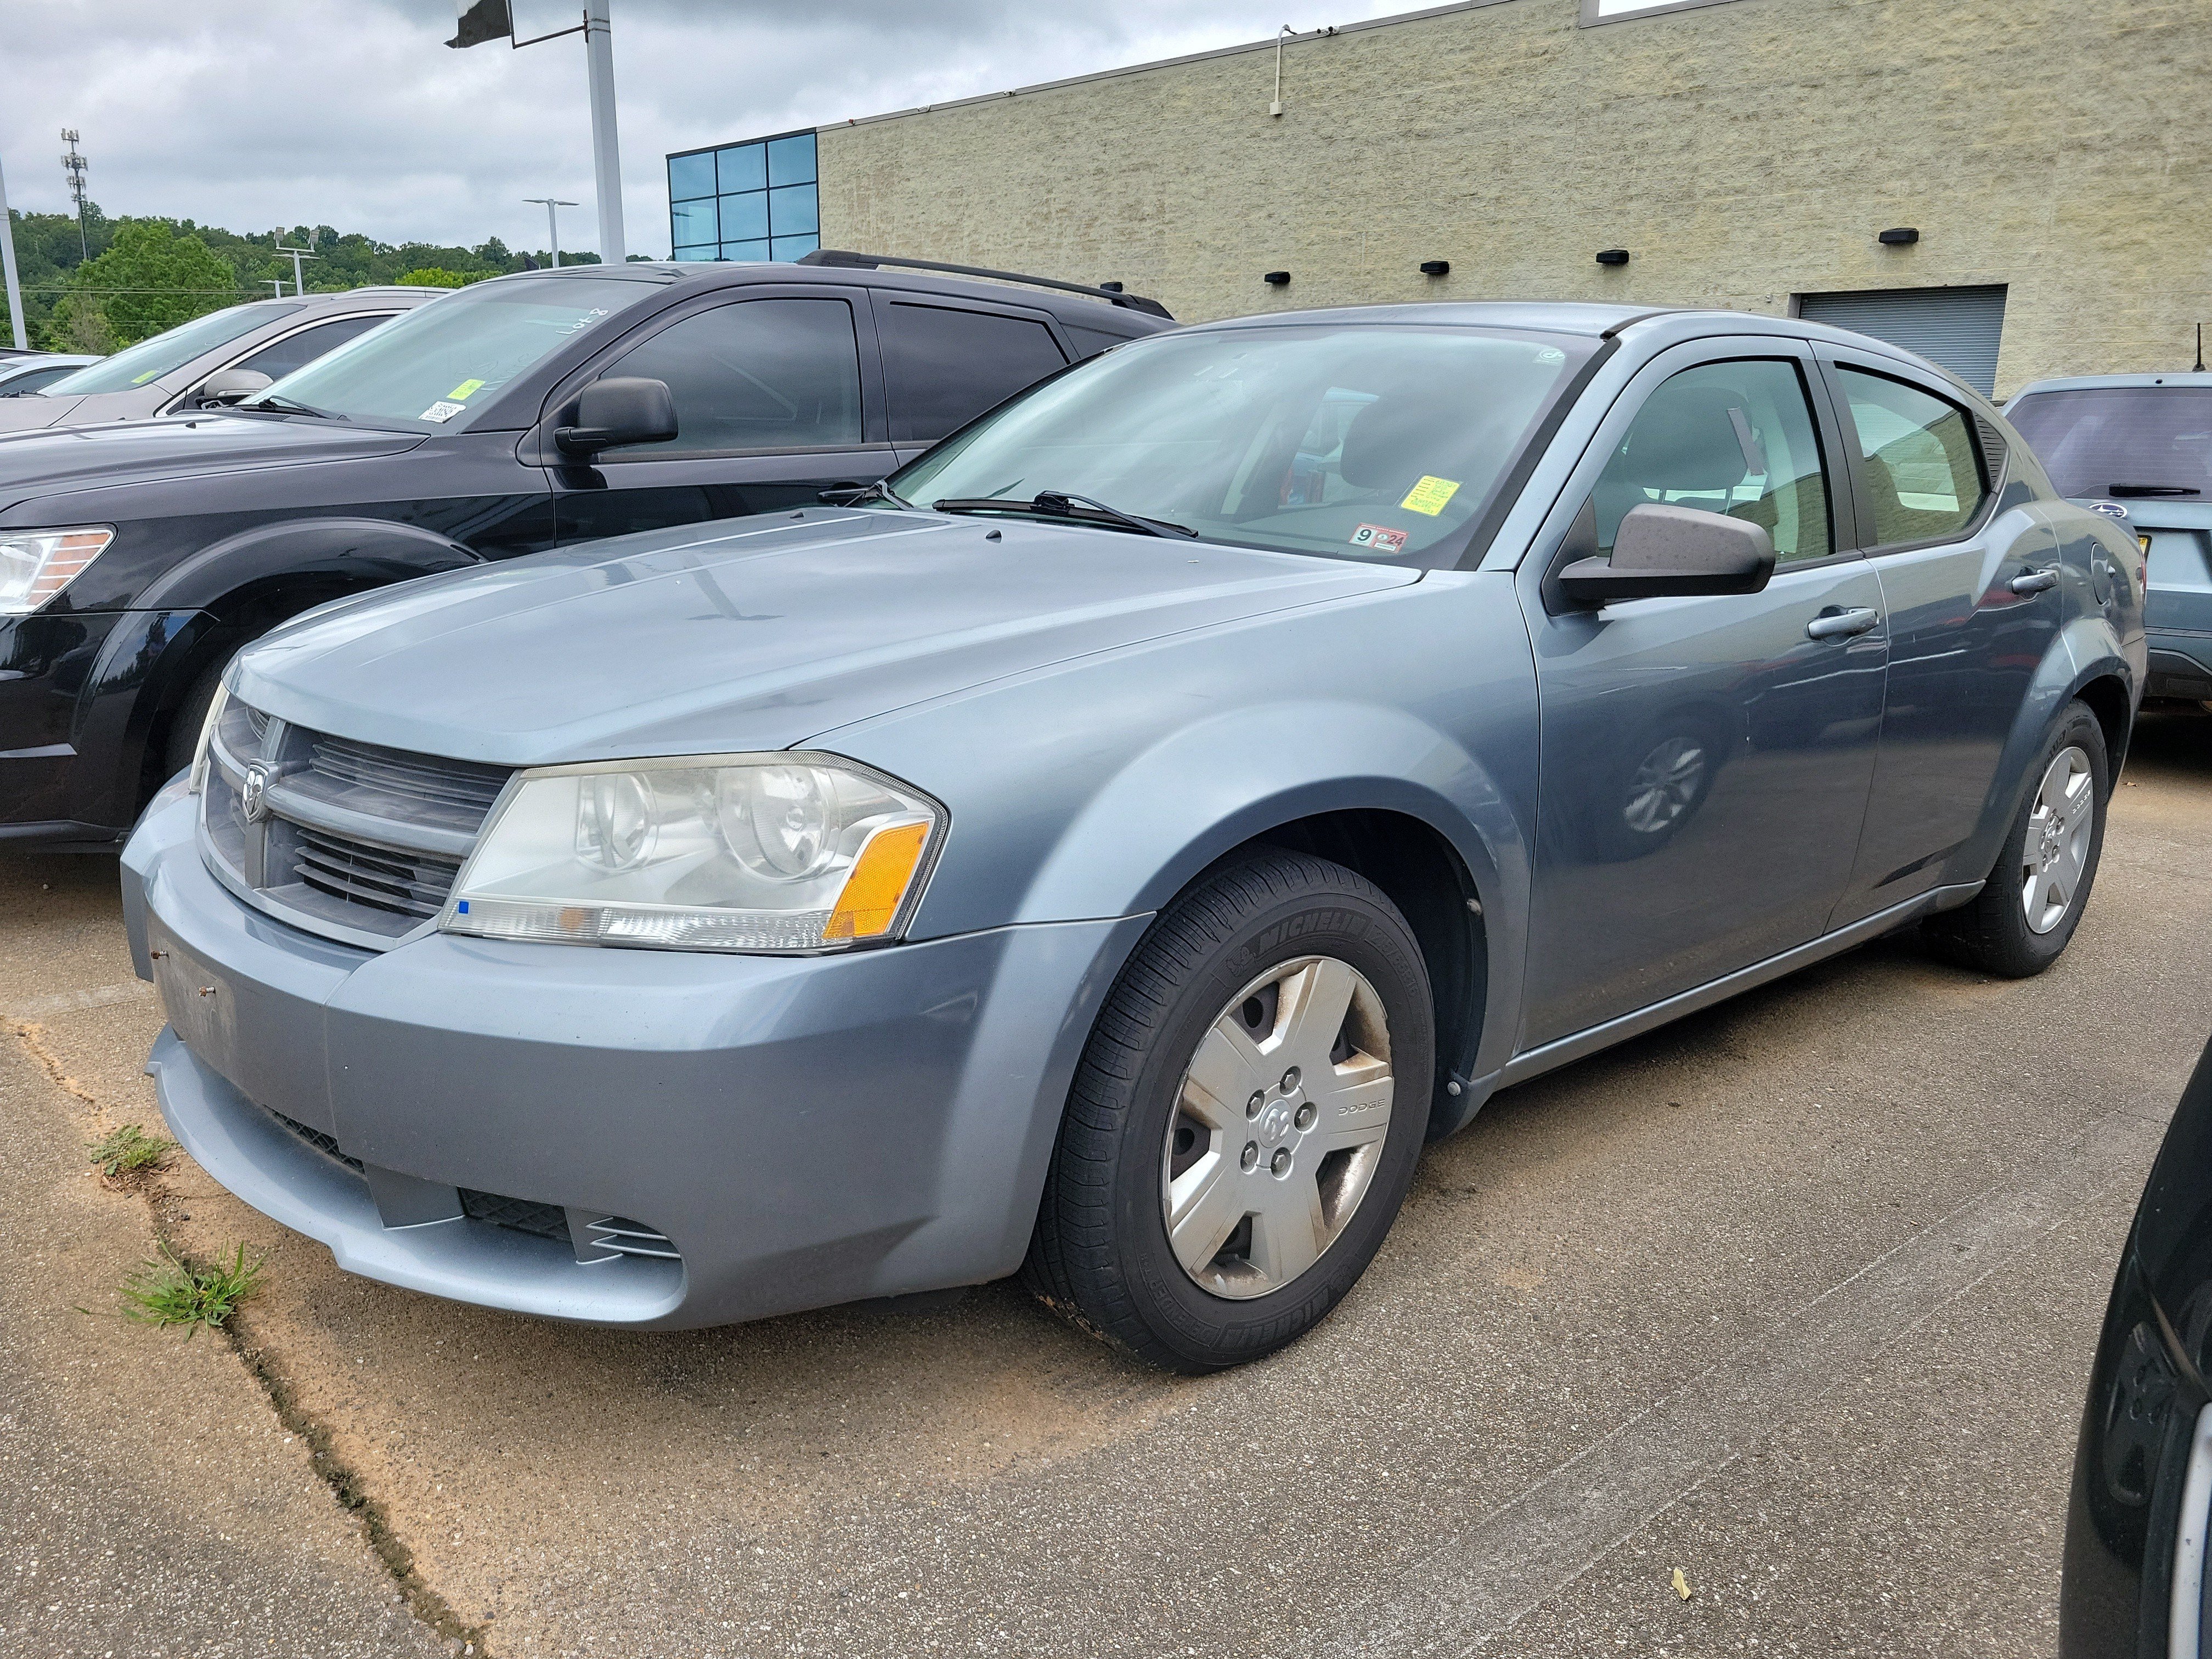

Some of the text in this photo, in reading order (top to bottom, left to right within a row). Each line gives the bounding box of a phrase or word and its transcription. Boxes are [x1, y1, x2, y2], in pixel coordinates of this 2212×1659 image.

[1357, 529, 1404, 546] 9 24
[1258, 912, 1366, 953] MICHELIN
[1339, 1099, 1385, 1115] DODGE
